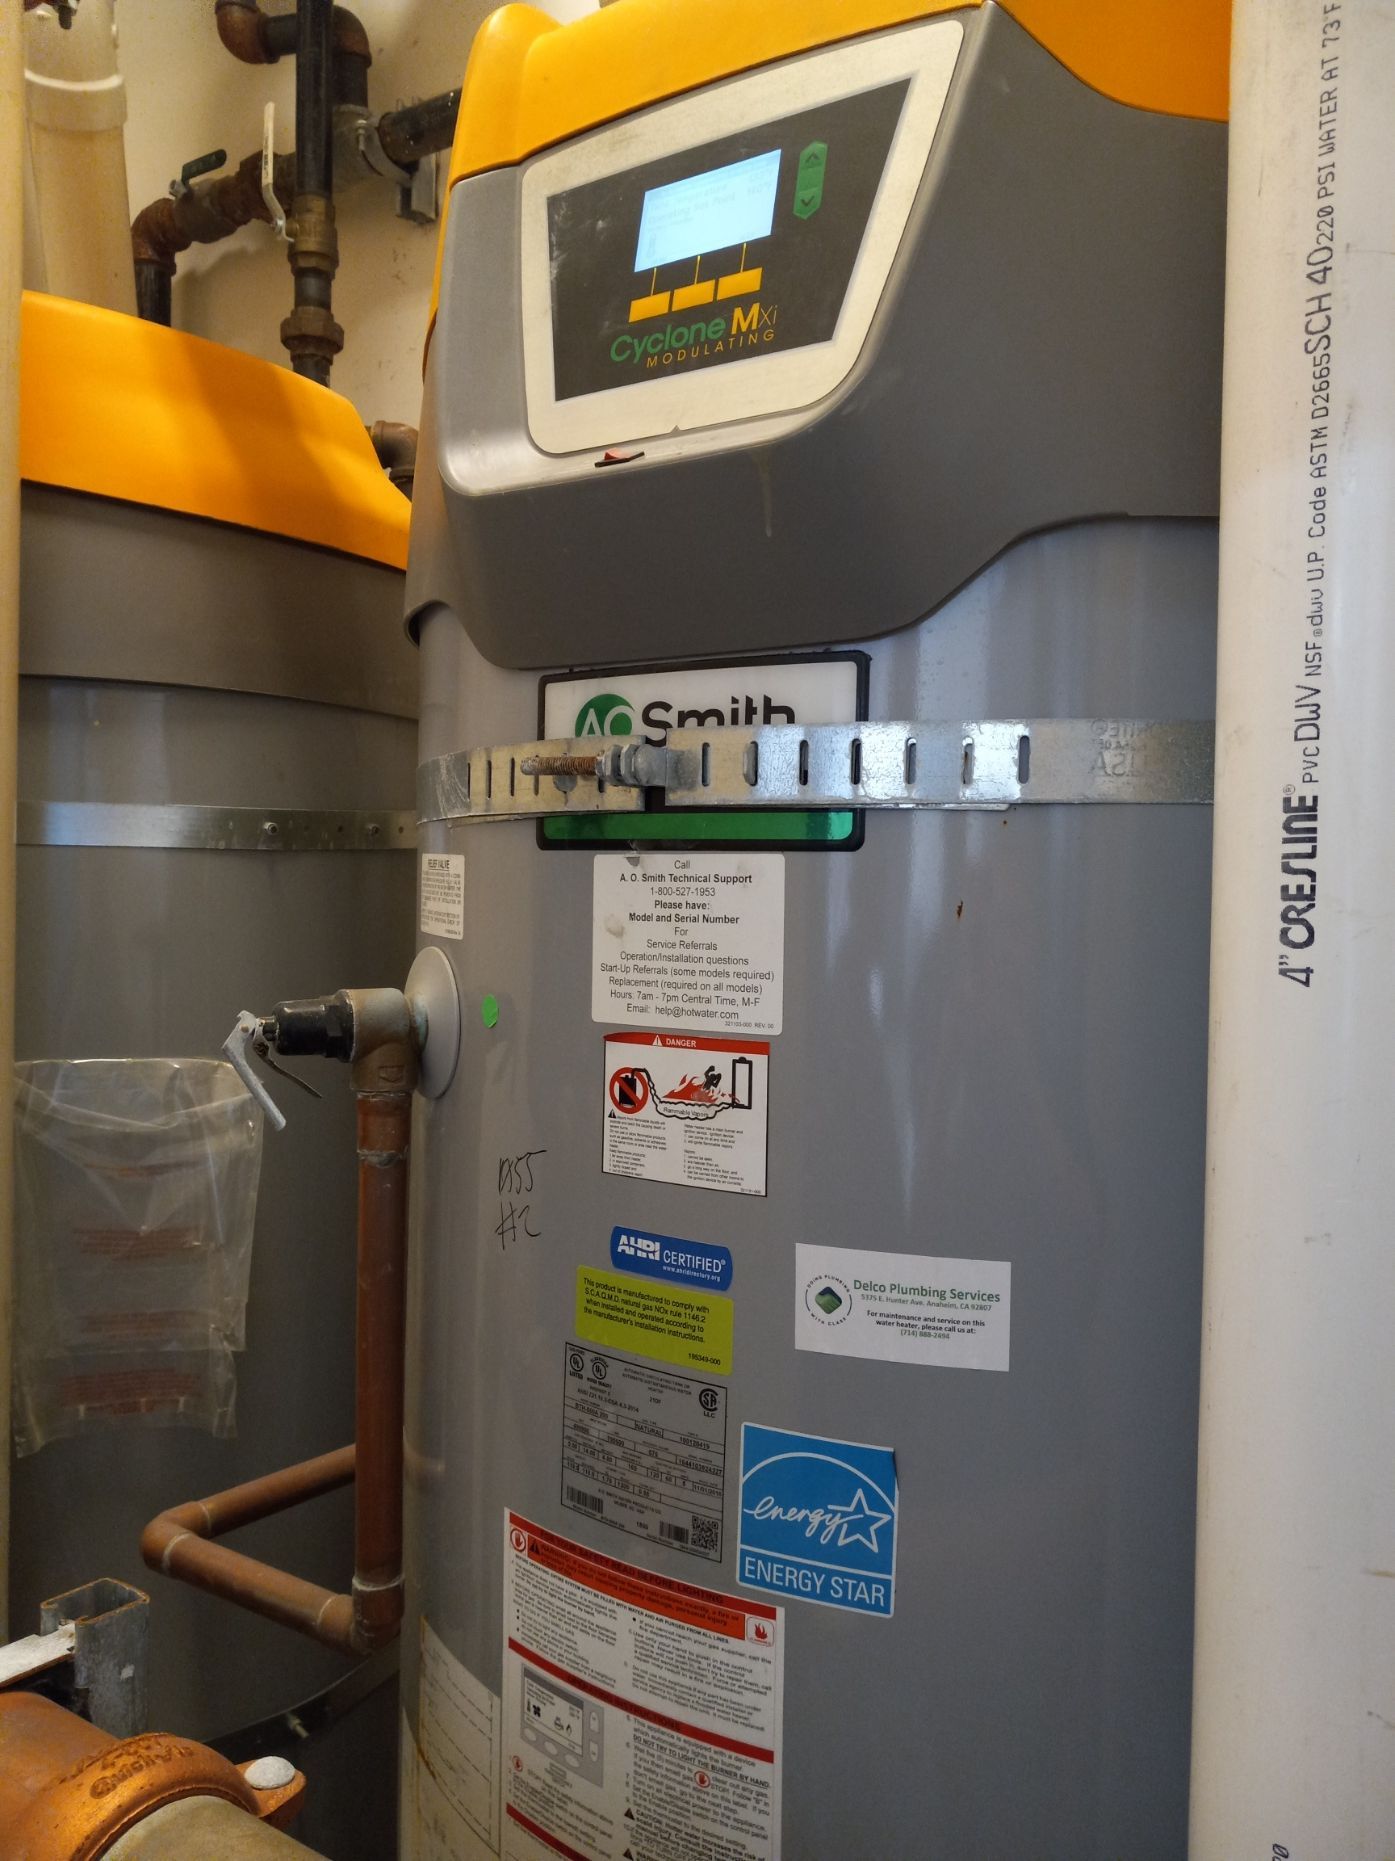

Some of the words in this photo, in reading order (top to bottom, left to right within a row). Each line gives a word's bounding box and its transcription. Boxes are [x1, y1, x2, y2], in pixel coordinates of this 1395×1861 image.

[1321, 56, 1339, 81] AT
[1318, 87, 1338, 158] WATER
[1317, 162, 1335, 200] PSI
[1317, 205, 1334, 245] 220
[1306, 245, 1333, 285] 40
[1304, 292, 1332, 354] SCH
[610, 318, 726, 364] Cyclone
[646, 329, 775, 368] MODULATING
[1312, 353, 1331, 420] D2665
[1310, 426, 1328, 478] ASTM
[1308, 486, 1327, 538] Code
[642, 694, 795, 730] Smith
[1294, 684, 1321, 742] DWV
[1302, 746, 1320, 783] PVC
[674, 860, 690, 869] Call
[642, 874, 665, 882] Smith
[668, 874, 711, 883] Technical
[714, 875, 752, 884] Support
[650, 888, 715, 897] 1-800-527-1953
[654, 901, 683, 910] Please
[685, 901, 710, 910] have:
[629, 913, 653, 922] Model
[656, 914, 671, 922] and
[674, 914, 699, 923] Serial
[702, 915, 740, 924] Number
[674, 927, 688, 936] For
[647, 939, 676, 949] Service
[679, 940, 717, 950] Referrals
[620, 952, 704, 964] Operation/Installation
[707, 956, 748, 967] questions
[601, 963, 630, 974] Start-Up
[633, 965, 668, 975] Referrals
[670, 967, 696, 977] (some
[699, 968, 730, 978] models
[733, 969, 774, 981] required)
[609, 976, 658, 988] Replacement
[661, 979, 697, 991] (required
[714, 981, 723, 991] all
[726, 982, 762, 994] models)
[637, 991, 653, 1000] 7am
[662, 992, 678, 1003] 7pm
[681, 994, 712, 1004] Central
[714, 996, 738, 1007] Time,
[742, 997, 760, 1007] M-F
[627, 1004, 650, 1013] Email:
[655, 1005, 739, 1020] help@hotwater.com
[666, 1038, 696, 1048] DANGER
[617, 1234, 660, 1261] AHRI
[662, 1266, 721, 1282] www.ahridirectory.org
[824, 1274, 850, 1293] PLUMBING
[584, 1278, 594, 1287] This
[596, 1280, 616, 1294] product
[623, 1289, 667, 1304] manufactured
[672, 1300, 694, 1312] comply
[696, 1305, 709, 1313] with
[853, 1279, 886, 1293] Delco
[890, 1283, 947, 1301] Plumbing
[950, 1288, 1000, 1303] Services
[886, 1296, 909, 1305] Hunter
[911, 1298, 924, 1307] Ave.
[926, 1300, 958, 1310] Anaheim,
[960, 1302, 969, 1310] CA
[586, 1298, 600, 1307] when
[602, 1302, 624, 1313] installed
[625, 1308, 636, 1316] and
[638, 1311, 664, 1324] operated
[665, 1317, 696, 1332] according
[621, 1298, 640, 1308] natural
[642, 1304, 653, 1312] gas
[655, 1306, 668, 1315] NOx
[670, 1309, 682, 1318] rule
[879, 1311, 921, 1322] maintenance
[923, 1314, 936, 1323] and
[937, 1316, 960, 1325] service
[972, 1318, 985, 1326] this
[593, 1308, 633, 1326] manufacturer's
[634, 1320, 666, 1334] installation
[667, 1329, 704, 1342] instructions.
[896, 1320, 920, 1330] heater,
[922, 1322, 942, 1332] please
[944, 1324, 956, 1332] call
[967, 1326, 976, 1334] at:
[900, 1329, 917, 1338] (714)
[744, 1496, 856, 1544] energy
[744, 1556, 825, 1594] ENERGY
[830, 1576, 885, 1607] STAR
